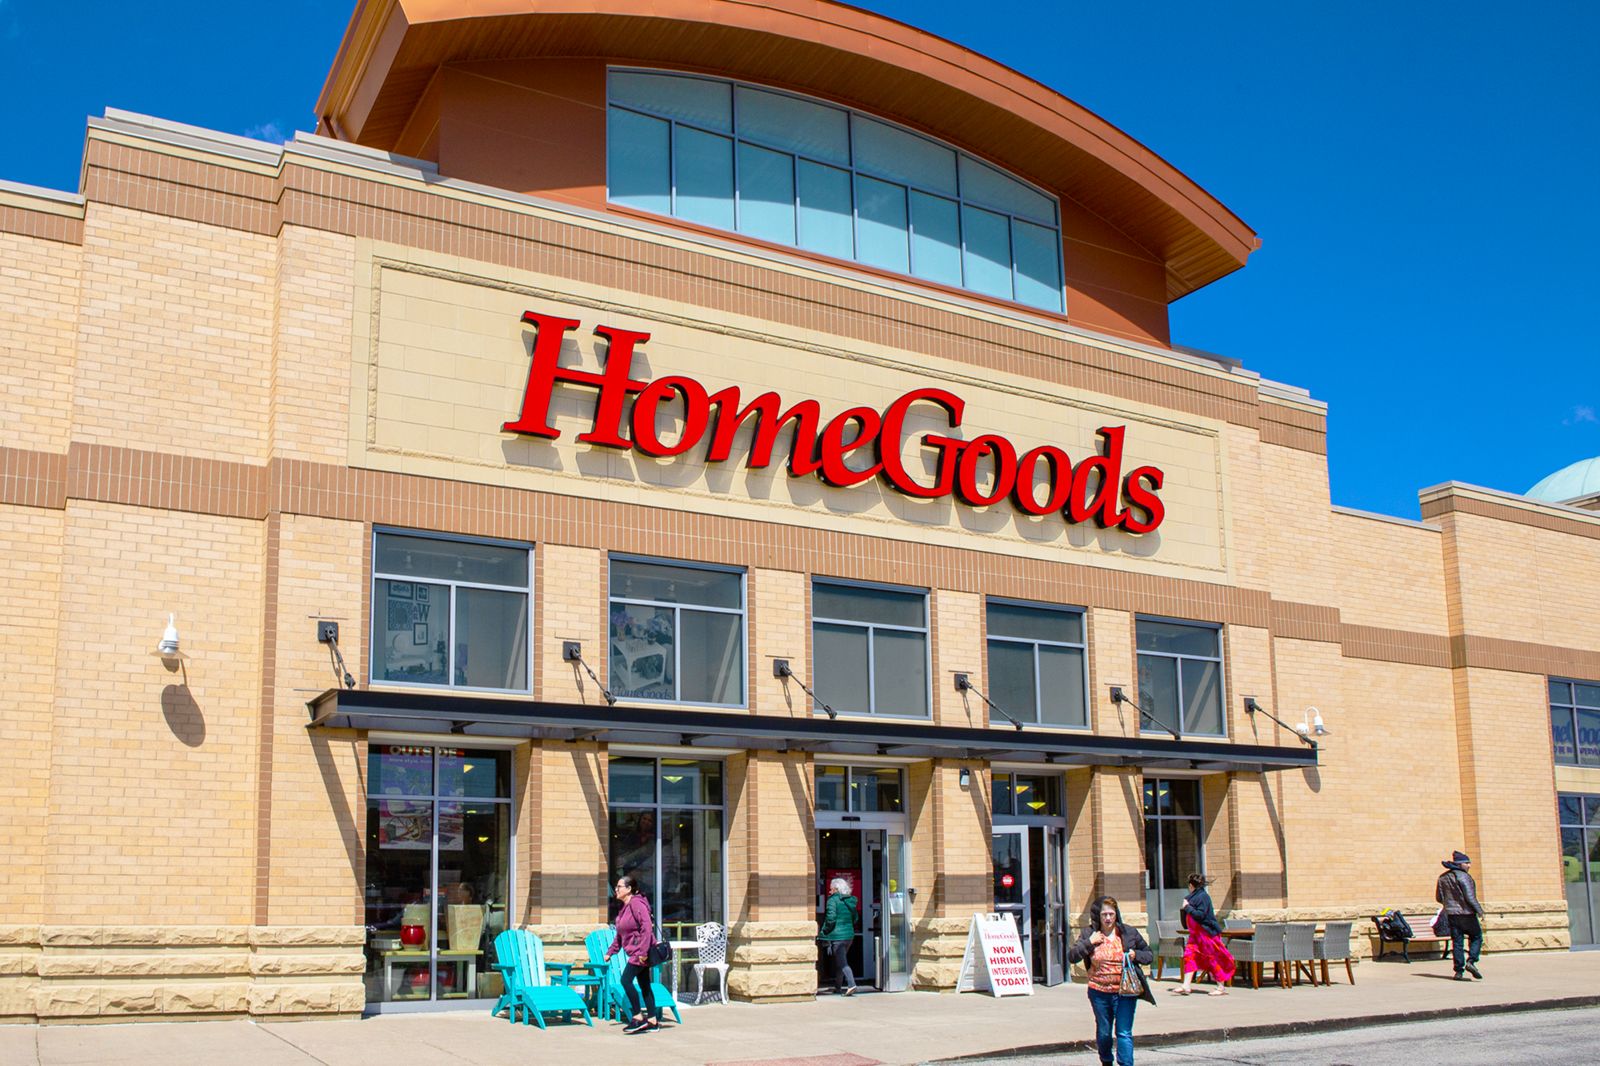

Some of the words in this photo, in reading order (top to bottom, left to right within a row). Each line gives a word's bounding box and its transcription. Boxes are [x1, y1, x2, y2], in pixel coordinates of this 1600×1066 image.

[501, 310, 1165, 534] HomeGoods
[390, 746, 457, 757] OUTSDE
[993, 946, 1015, 954] NOW
[989, 956, 1024, 965] HIRING
[992, 966, 1027, 975] INTERVIEWS
[995, 977, 1029, 987] TODAY!
